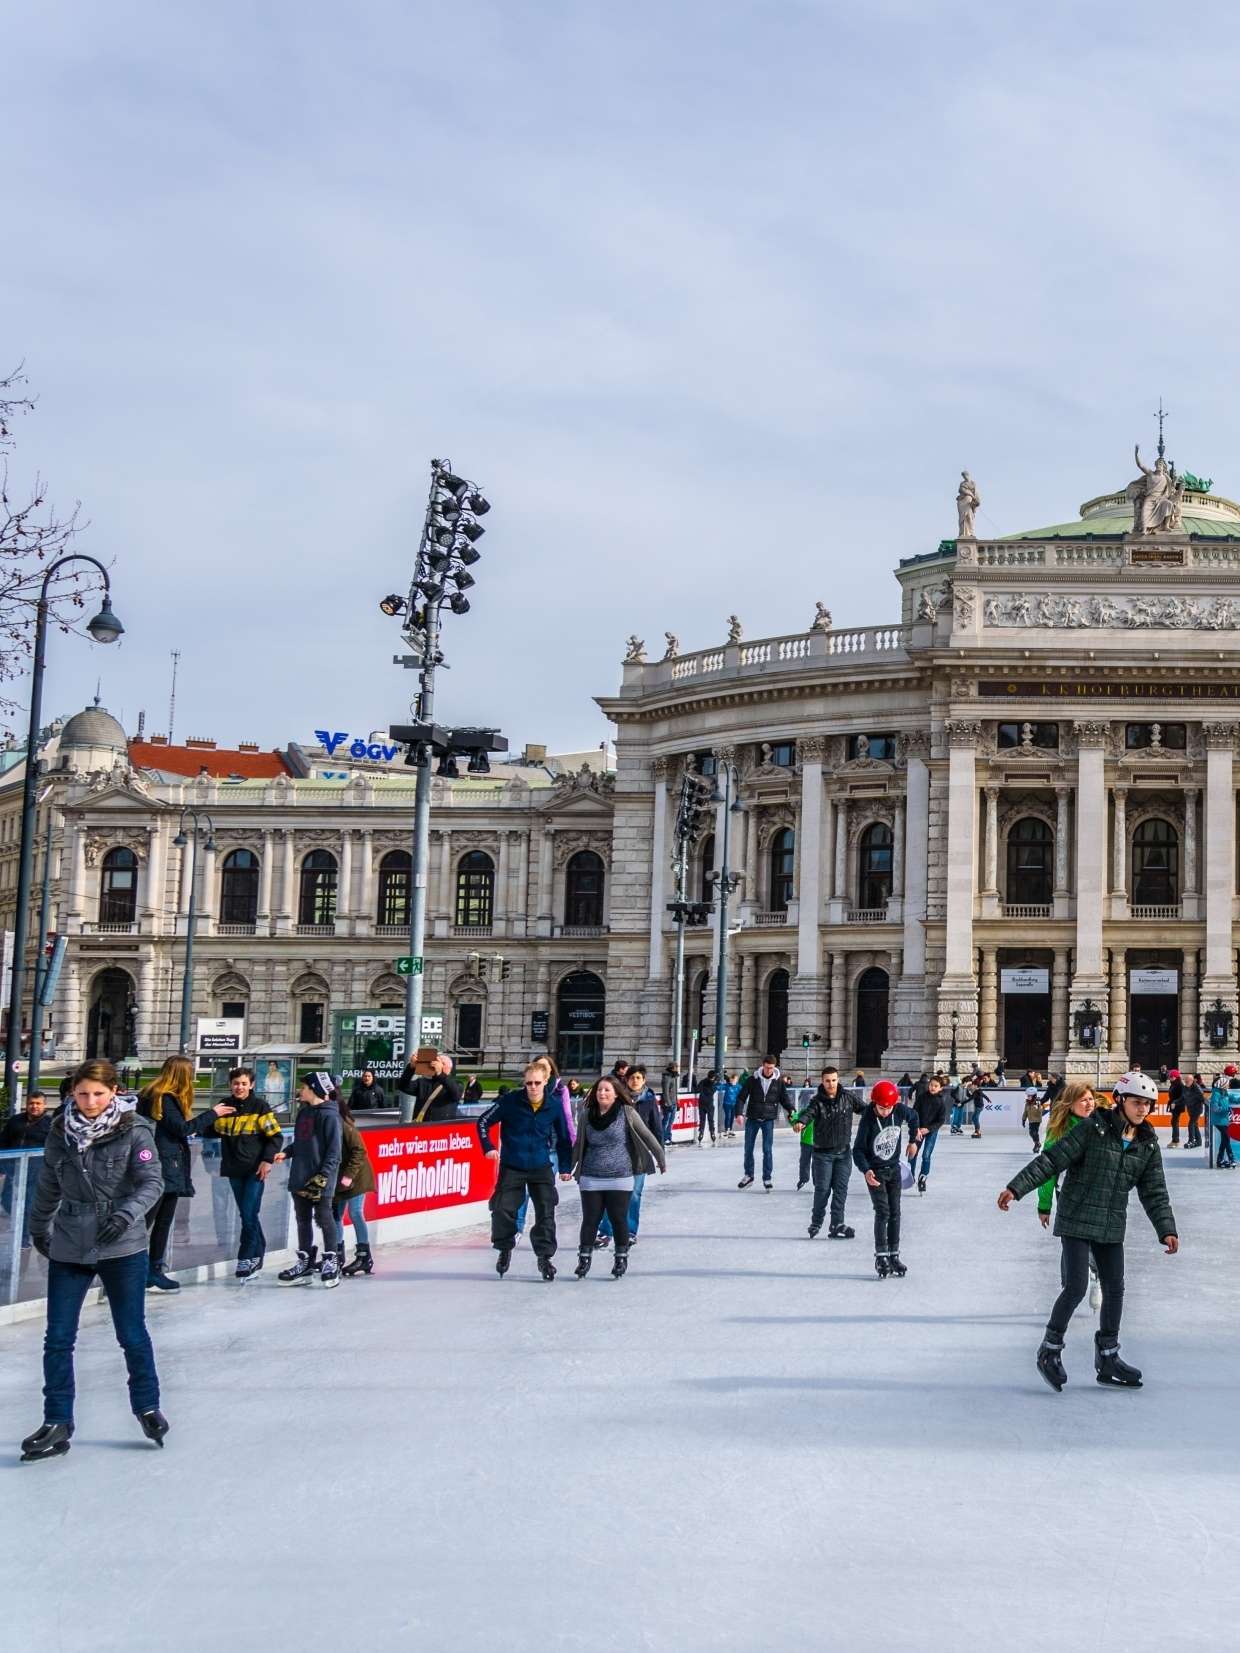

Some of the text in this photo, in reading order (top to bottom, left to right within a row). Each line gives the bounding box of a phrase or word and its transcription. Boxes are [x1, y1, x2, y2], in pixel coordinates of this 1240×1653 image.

[350, 738, 399, 761] ÖGV
[378, 1132, 473, 1158] mehr wien zum leben.
